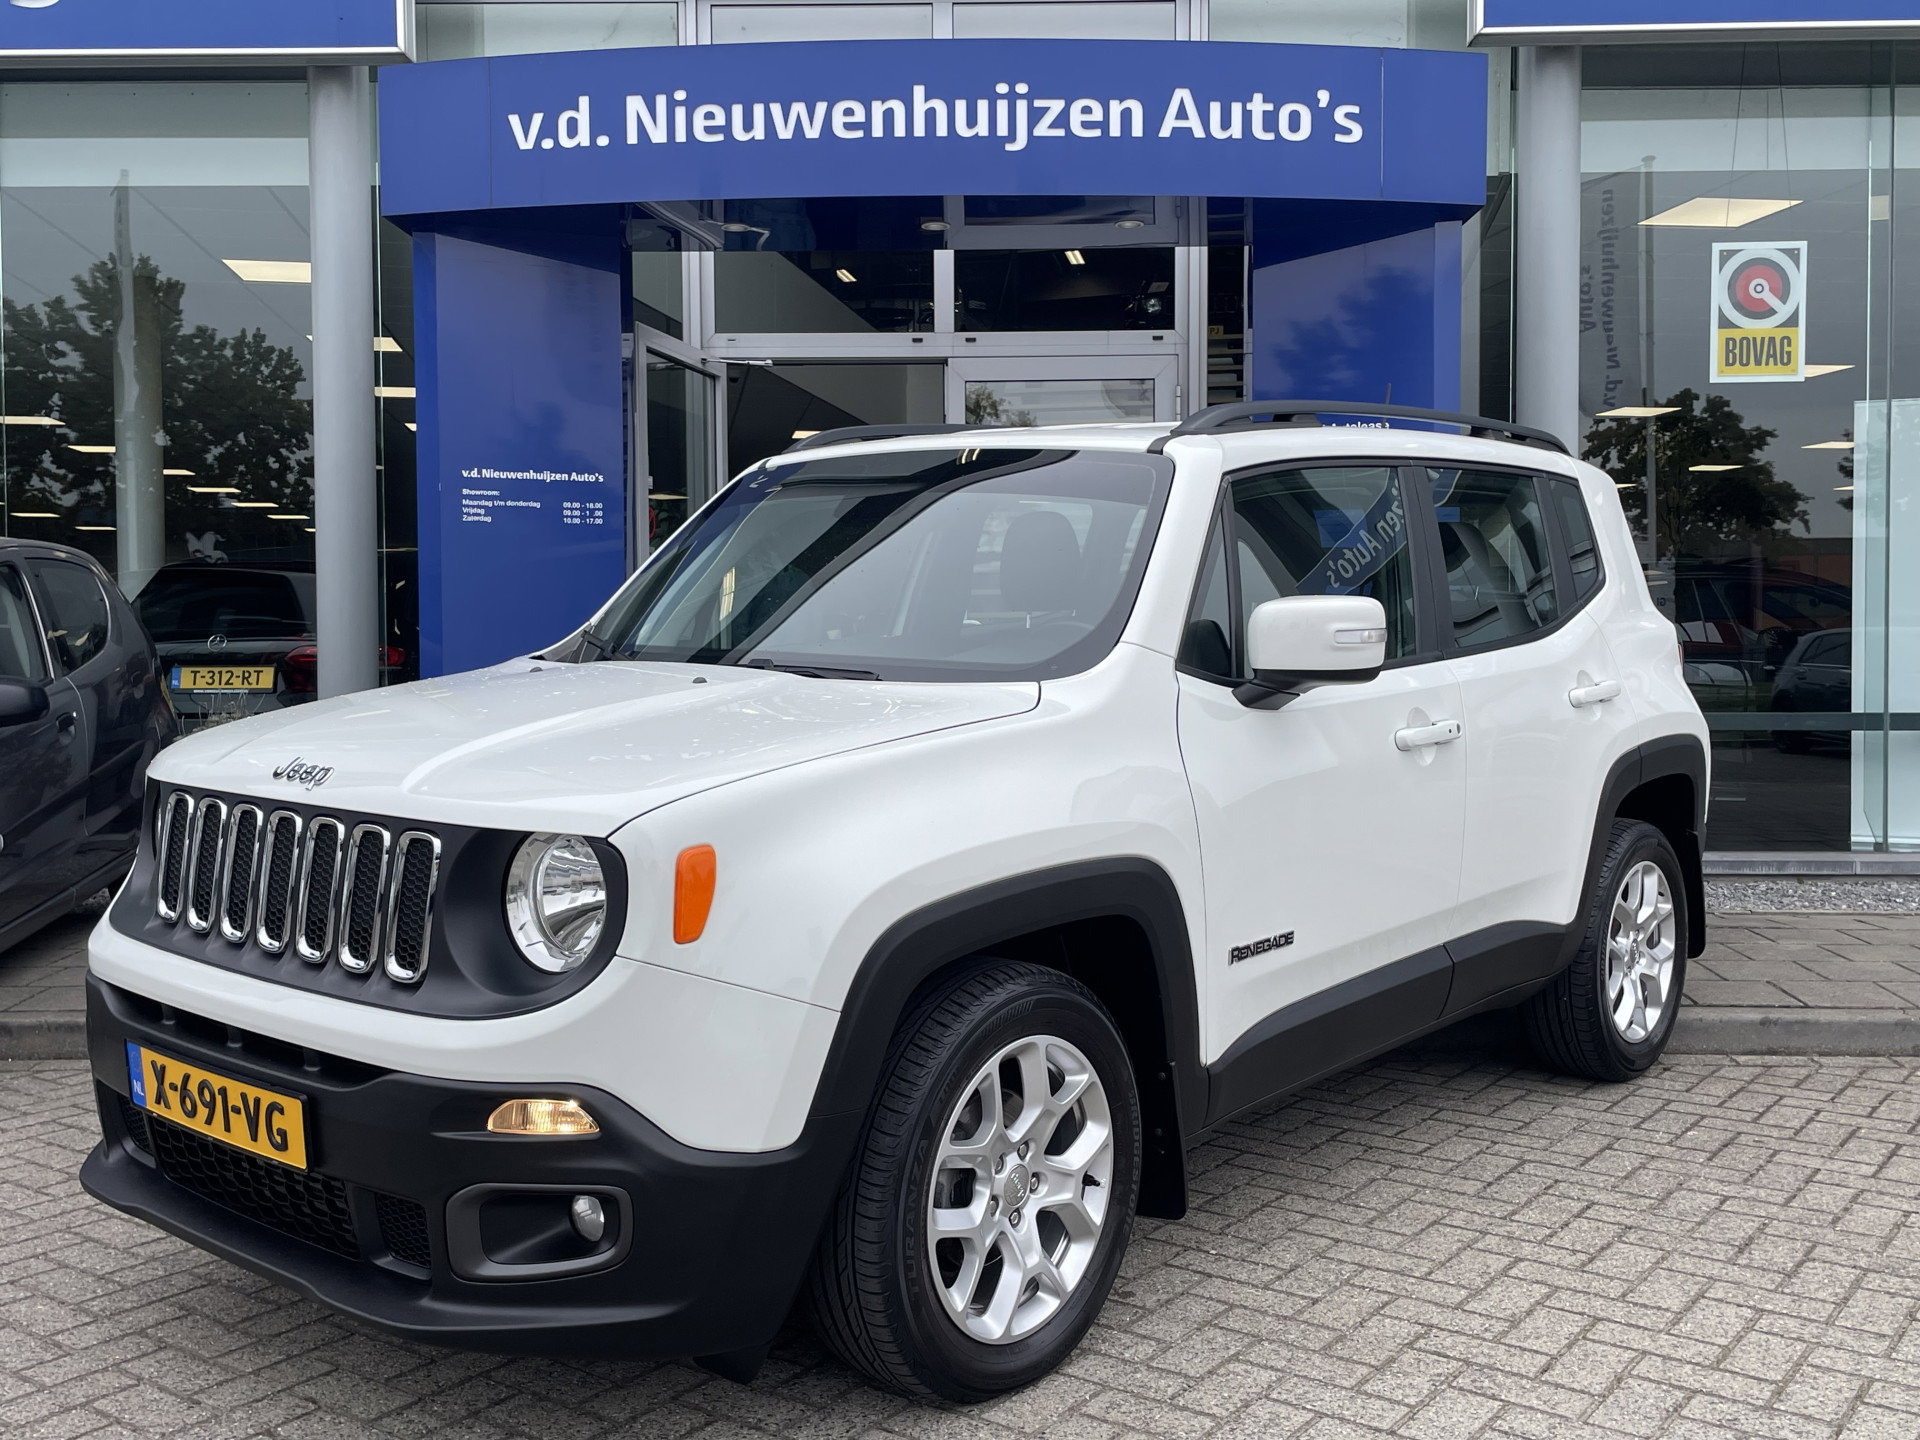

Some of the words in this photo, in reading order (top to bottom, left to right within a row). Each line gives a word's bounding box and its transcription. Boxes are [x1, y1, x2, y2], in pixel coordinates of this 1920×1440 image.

[507, 95, 610, 150] v.d.
[625, 82, 1144, 152] Nieuwenhuijzen
[1158, 87, 1364, 144] Auto's
[1724, 336, 1792, 367] BOVAG
[462, 468, 481, 478] v.d.
[482, 468, 569, 482] Nieuwenhuijzen
[570, 472, 604, 482] Auto's
[462, 488, 500, 497] Showroom:
[462, 499, 493, 508] Maandag
[506, 500, 541, 508] donderdag
[462, 507, 485, 515] Vrijdag
[190, 670, 264, 686] T-312-RT
[272, 756, 335, 791] Jeep
[1228, 930, 1295, 966] RENEGADE
[133, 1079, 144, 1096] NL
[151, 1060, 289, 1152] X-691-VG
